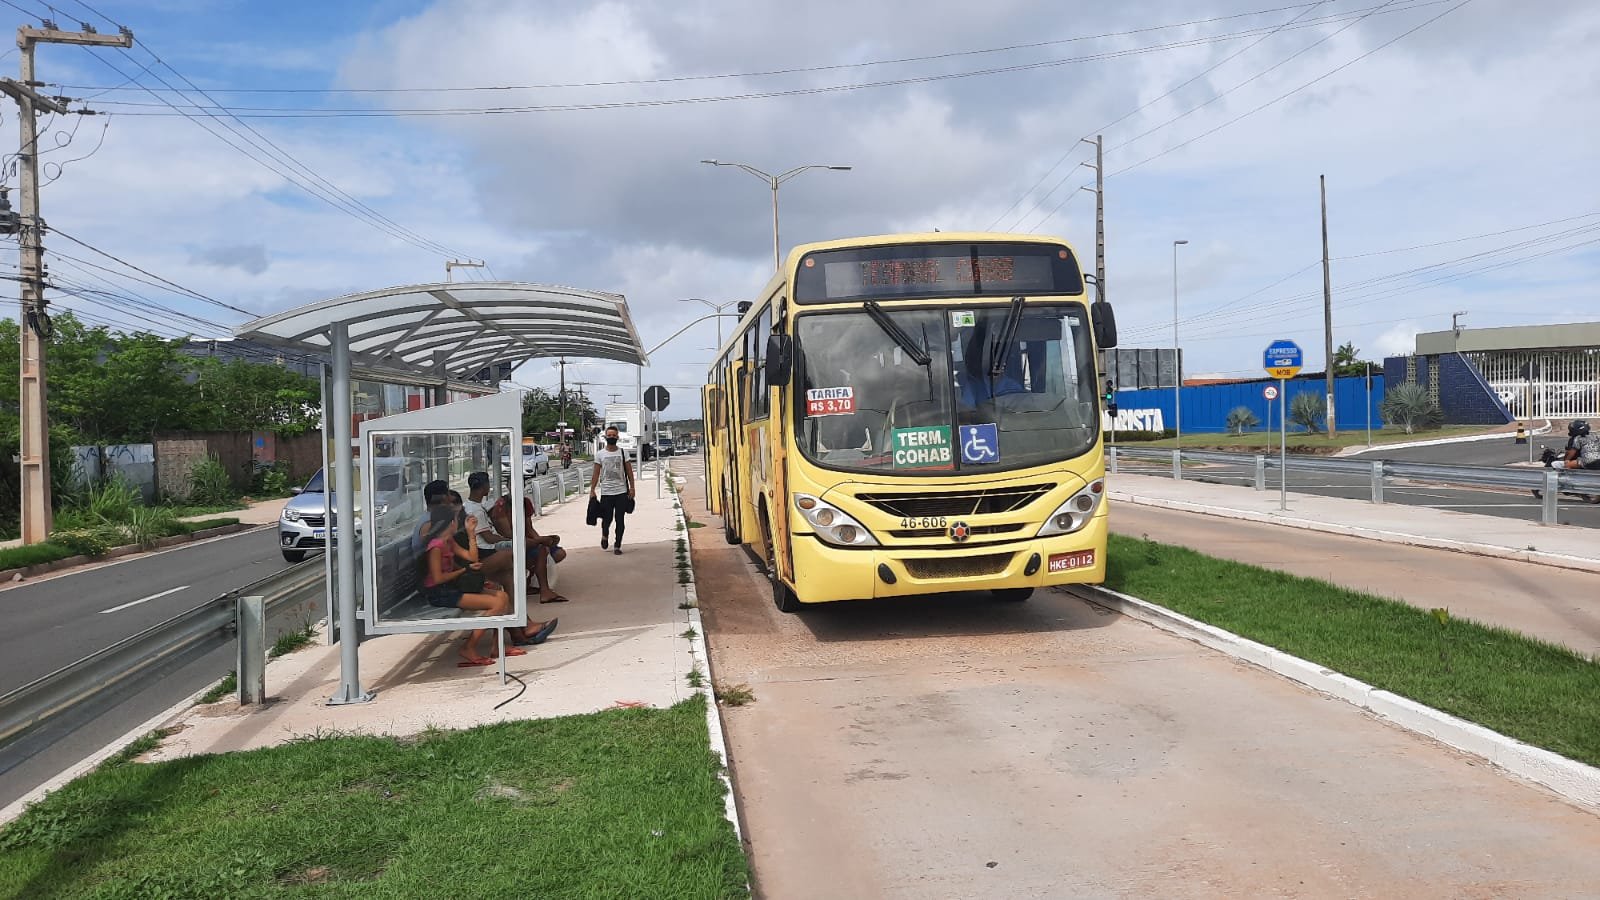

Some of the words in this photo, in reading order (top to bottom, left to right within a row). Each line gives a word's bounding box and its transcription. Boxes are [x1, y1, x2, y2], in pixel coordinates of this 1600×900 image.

[810, 388, 850, 400] TARIFA
[810, 401, 824, 412] R$
[827, 399, 851, 412] 3,70
[897, 430, 946, 447] TERM.
[895, 448, 951, 465] COHAB
